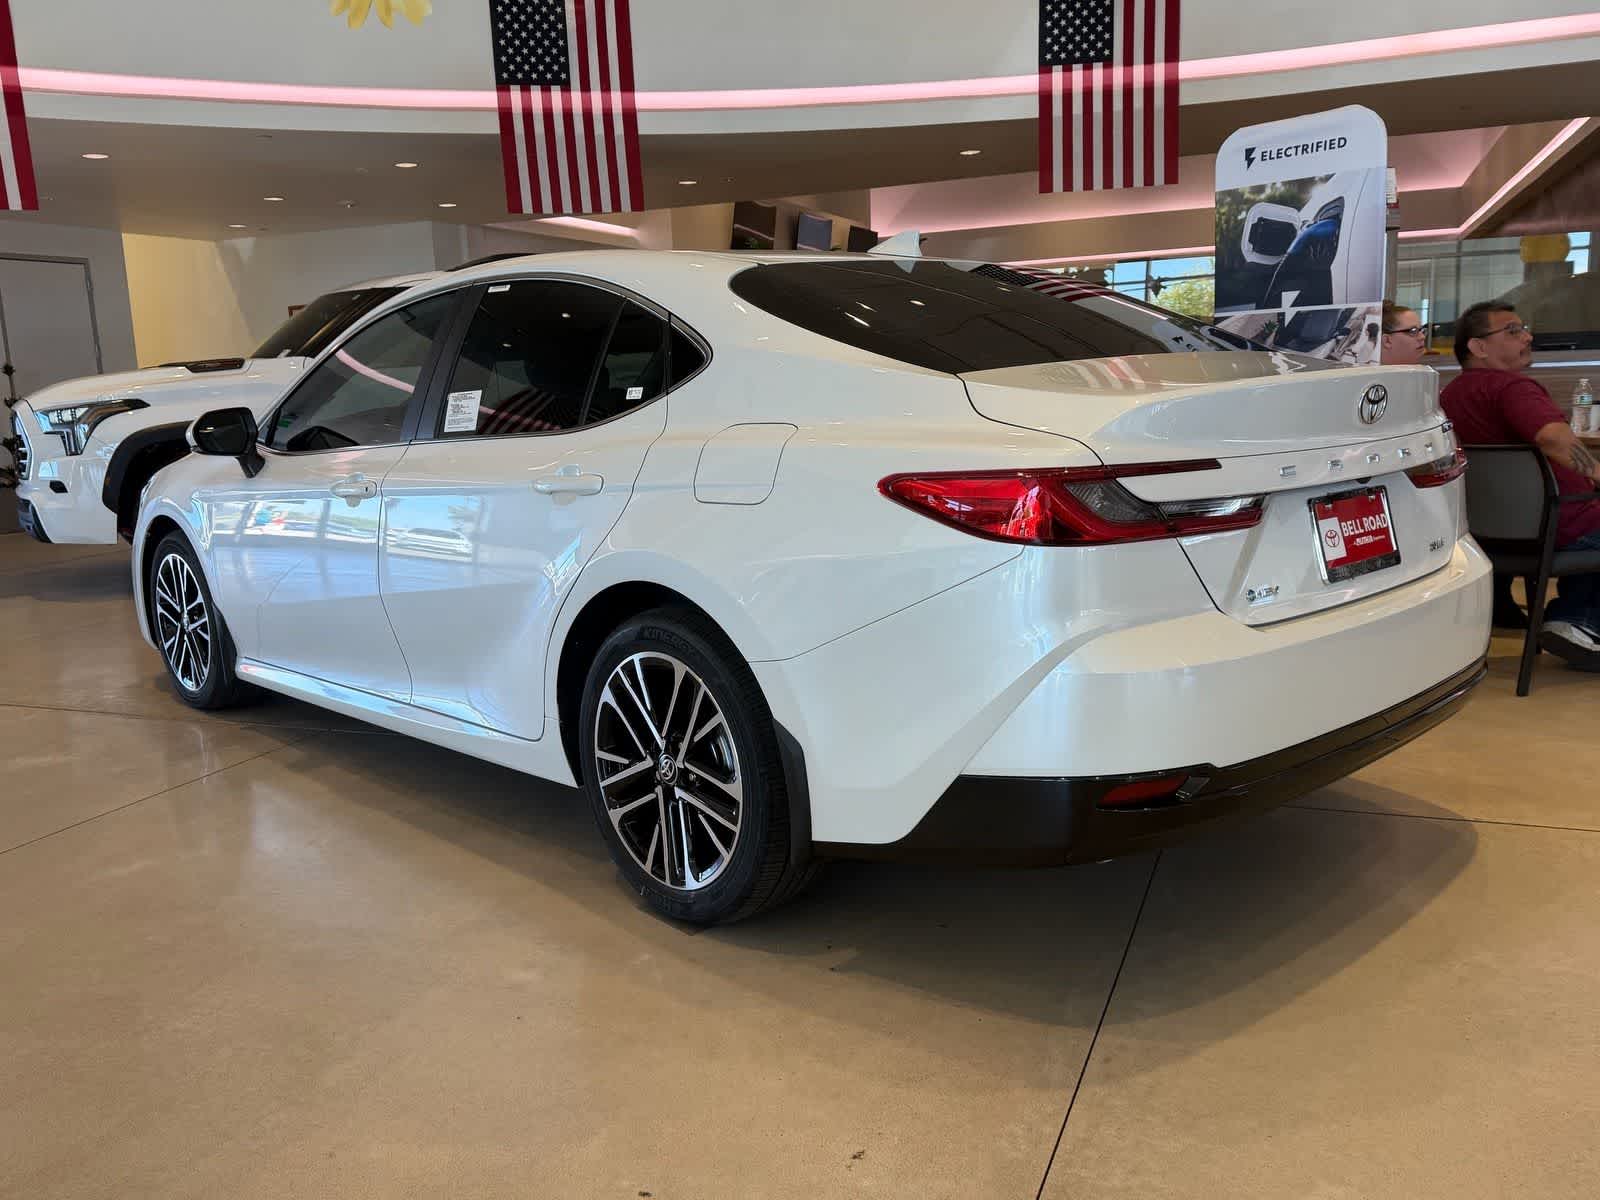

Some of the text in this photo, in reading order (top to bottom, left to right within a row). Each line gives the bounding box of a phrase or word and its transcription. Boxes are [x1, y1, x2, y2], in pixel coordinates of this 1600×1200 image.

[1260, 136, 1347, 162] ELECTRIFIED
[1341, 513, 1388, 537] BELL ROAD
